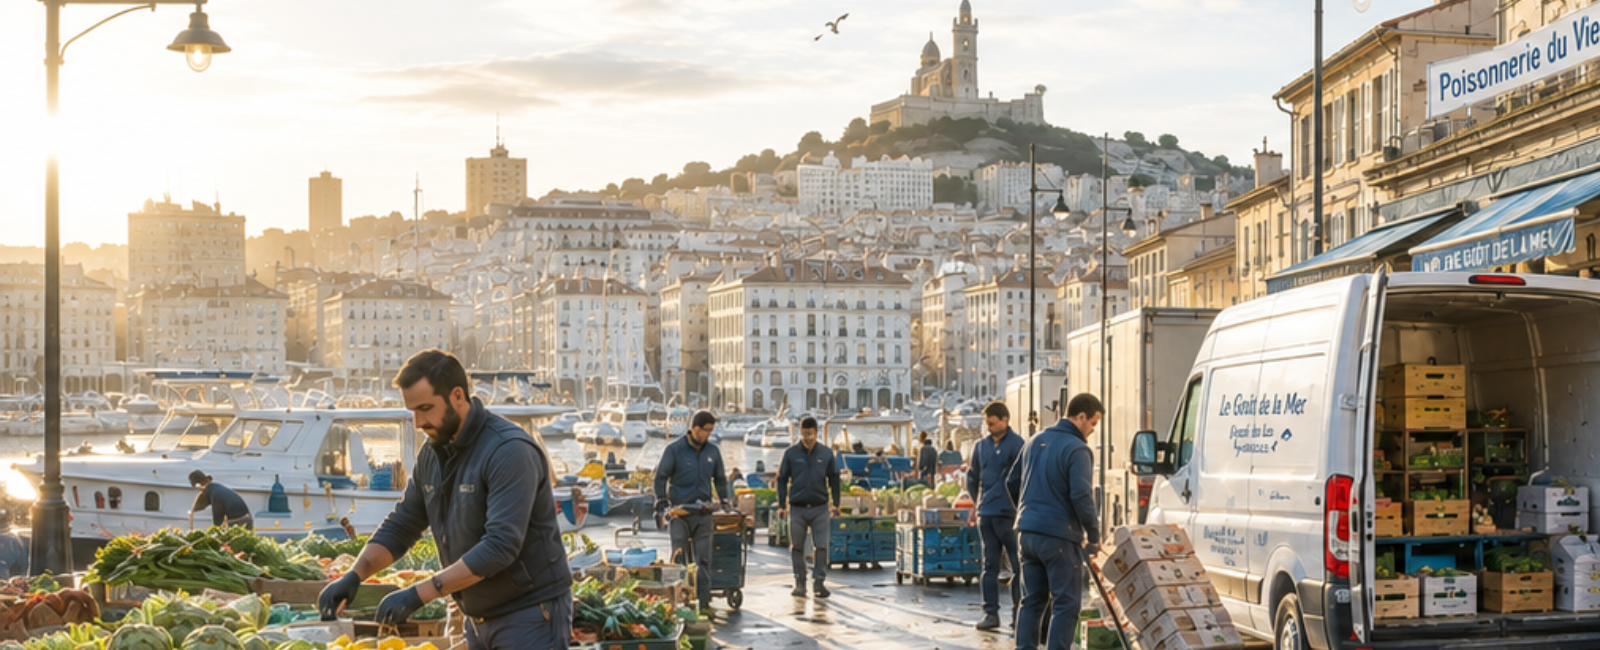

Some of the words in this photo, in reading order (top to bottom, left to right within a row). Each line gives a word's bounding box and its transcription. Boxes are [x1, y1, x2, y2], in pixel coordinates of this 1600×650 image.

[1439, 43, 1541, 102] Poisonnerie
[1547, 31, 1568, 63] du
[1284, 392, 1308, 416] Mer
